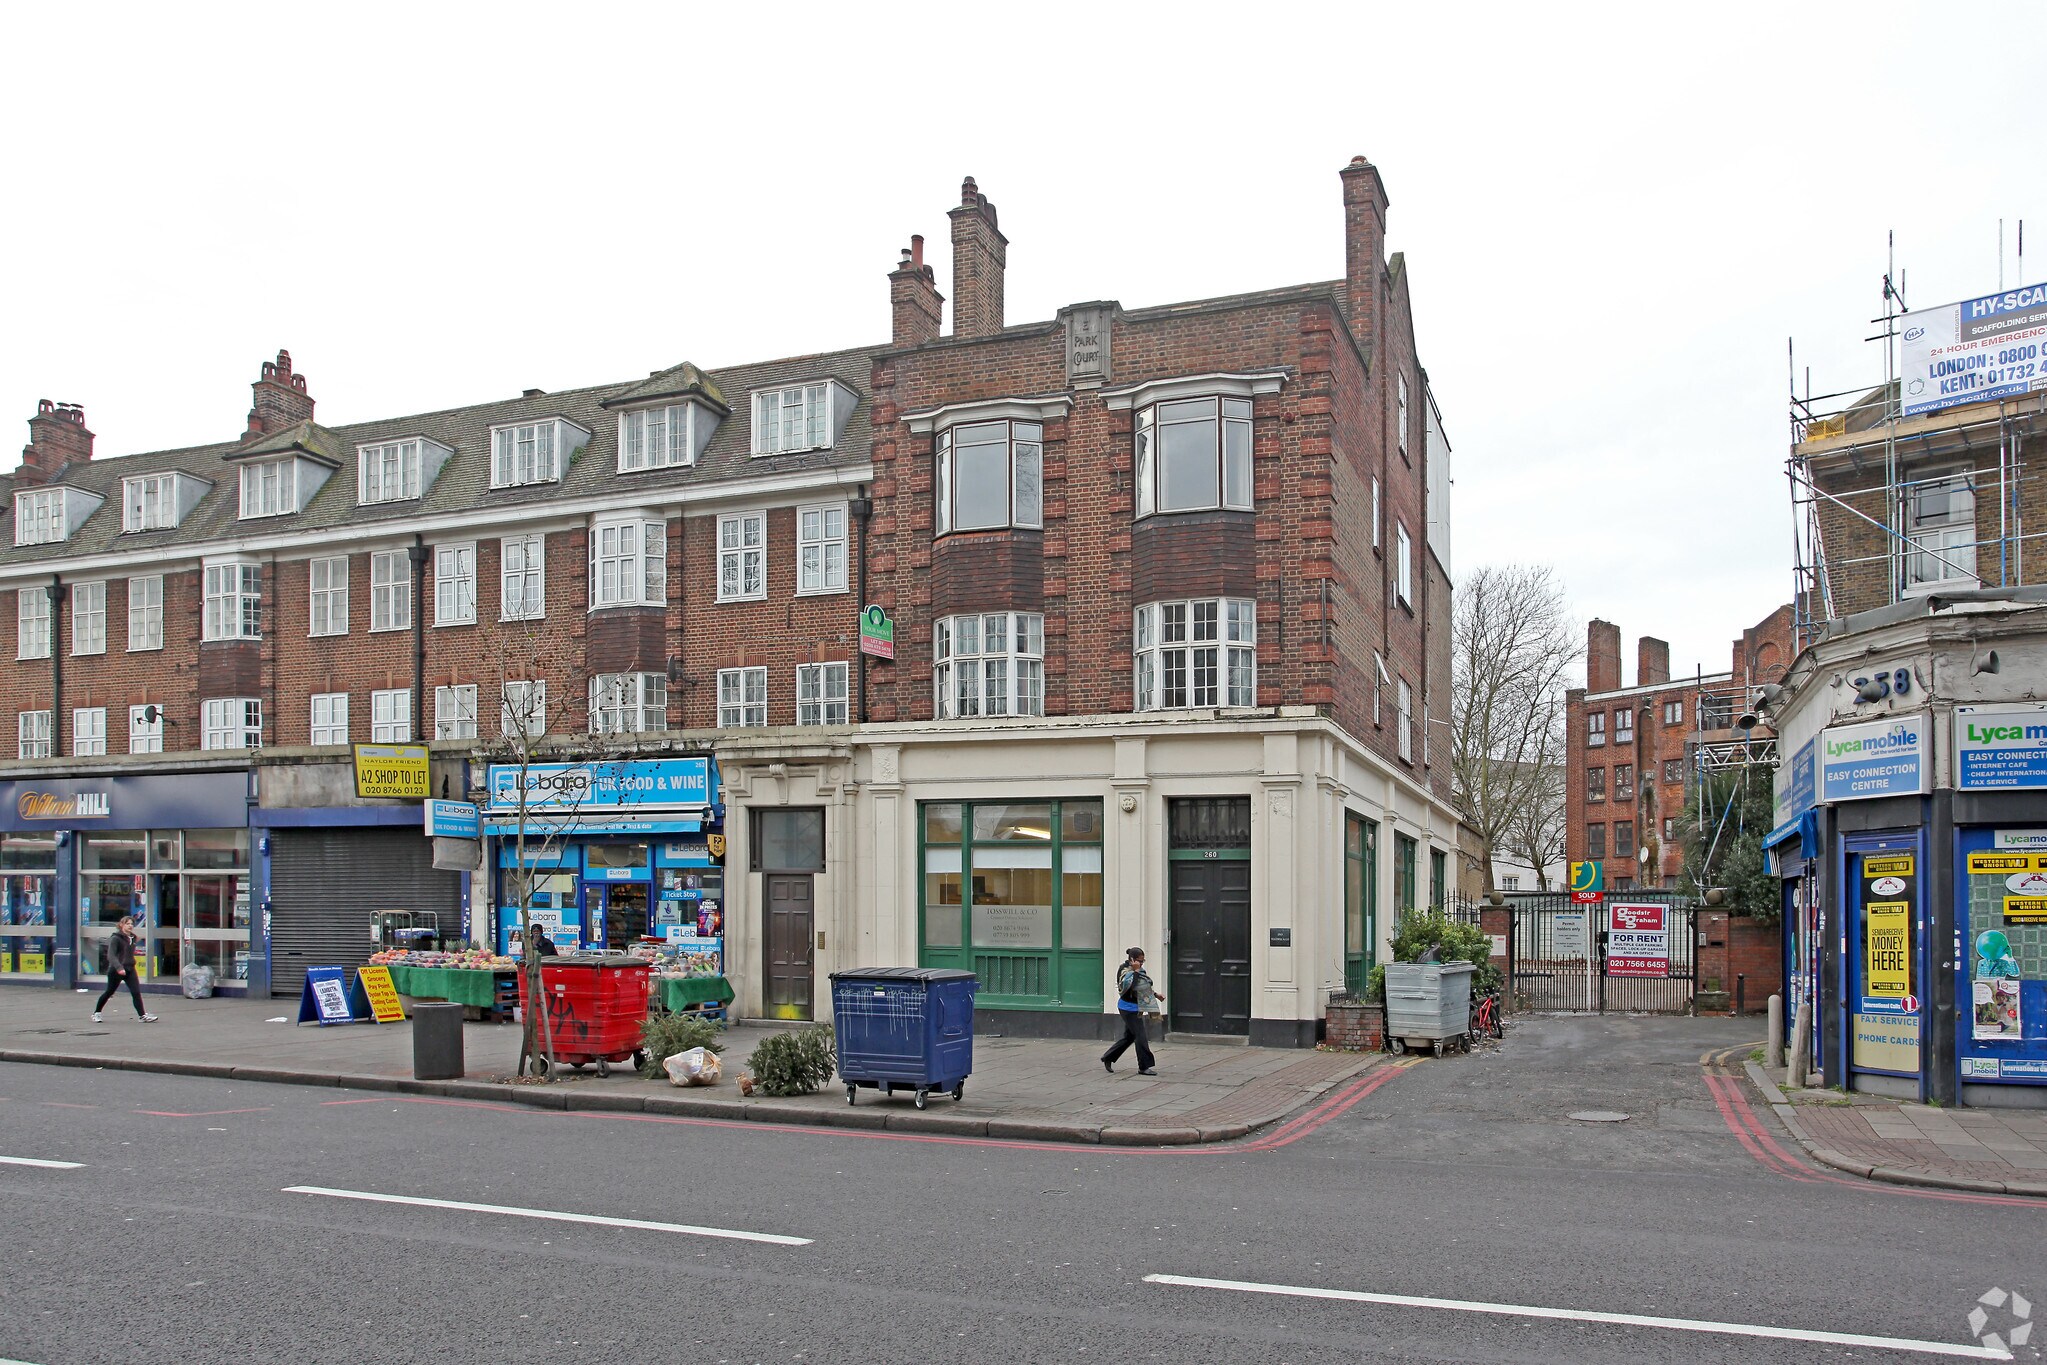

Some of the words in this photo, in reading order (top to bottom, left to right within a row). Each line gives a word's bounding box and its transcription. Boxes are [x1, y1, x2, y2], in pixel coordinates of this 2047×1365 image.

[1971, 316, 2027, 335] SCAFFOLDING
[1074, 335, 1098, 347] PARK
[1930, 348, 1943, 356] 24
[1947, 342, 1978, 353] HOUR
[1998, 344, 2037, 365] 0800
[1073, 351, 1099, 366] COURT
[1987, 363, 2035, 384] 01732
[1908, 385, 2024, 413] www.hy-scaff.co.uk
[1827, 725, 1917, 757] Lycamobile
[1968, 753, 1994, 761] EASY
[361, 769, 373, 783] A2
[375, 770, 398, 784] SHOP
[400, 770, 411, 784] TO
[413, 770, 426, 784] LET
[1827, 771, 1850, 781] EASY
[1853, 763, 1916, 778] CONNECTION
[515, 773, 587, 790] Lebara
[599, 778, 617, 791] UK
[620, 777, 654, 791] FOOD
[657, 776, 667, 789] &
[669, 776, 704, 789] WINE
[1851, 779, 1889, 791] CENTRE
[365, 786, 381, 794] 020
[382, 786, 402, 794] 8766
[404, 786, 424, 794] 0123
[76, 793, 110, 815] HILL
[444, 806, 474, 815] Lebara
[683, 891, 697, 899] Stop
[529, 912, 557, 921] Lebara
[1616, 907, 1651, 921] goodsir
[1625, 915, 1658, 929] graham
[1614, 934, 1634, 942] FOR
[1637, 935, 1664, 943] RENT
[1872, 936, 1904, 950] MONEY
[1626, 960, 1645, 968] 7566
[1872, 951, 1904, 971] HERE
[1861, 1015, 1877, 1023] FAX
[1880, 1016, 1918, 1026] SERVICE
[1858, 1034, 1887, 1043] PHONE
[1890, 1036, 1920, 1046] CARDS
[1973, 1060, 1998, 1069] Lyca
